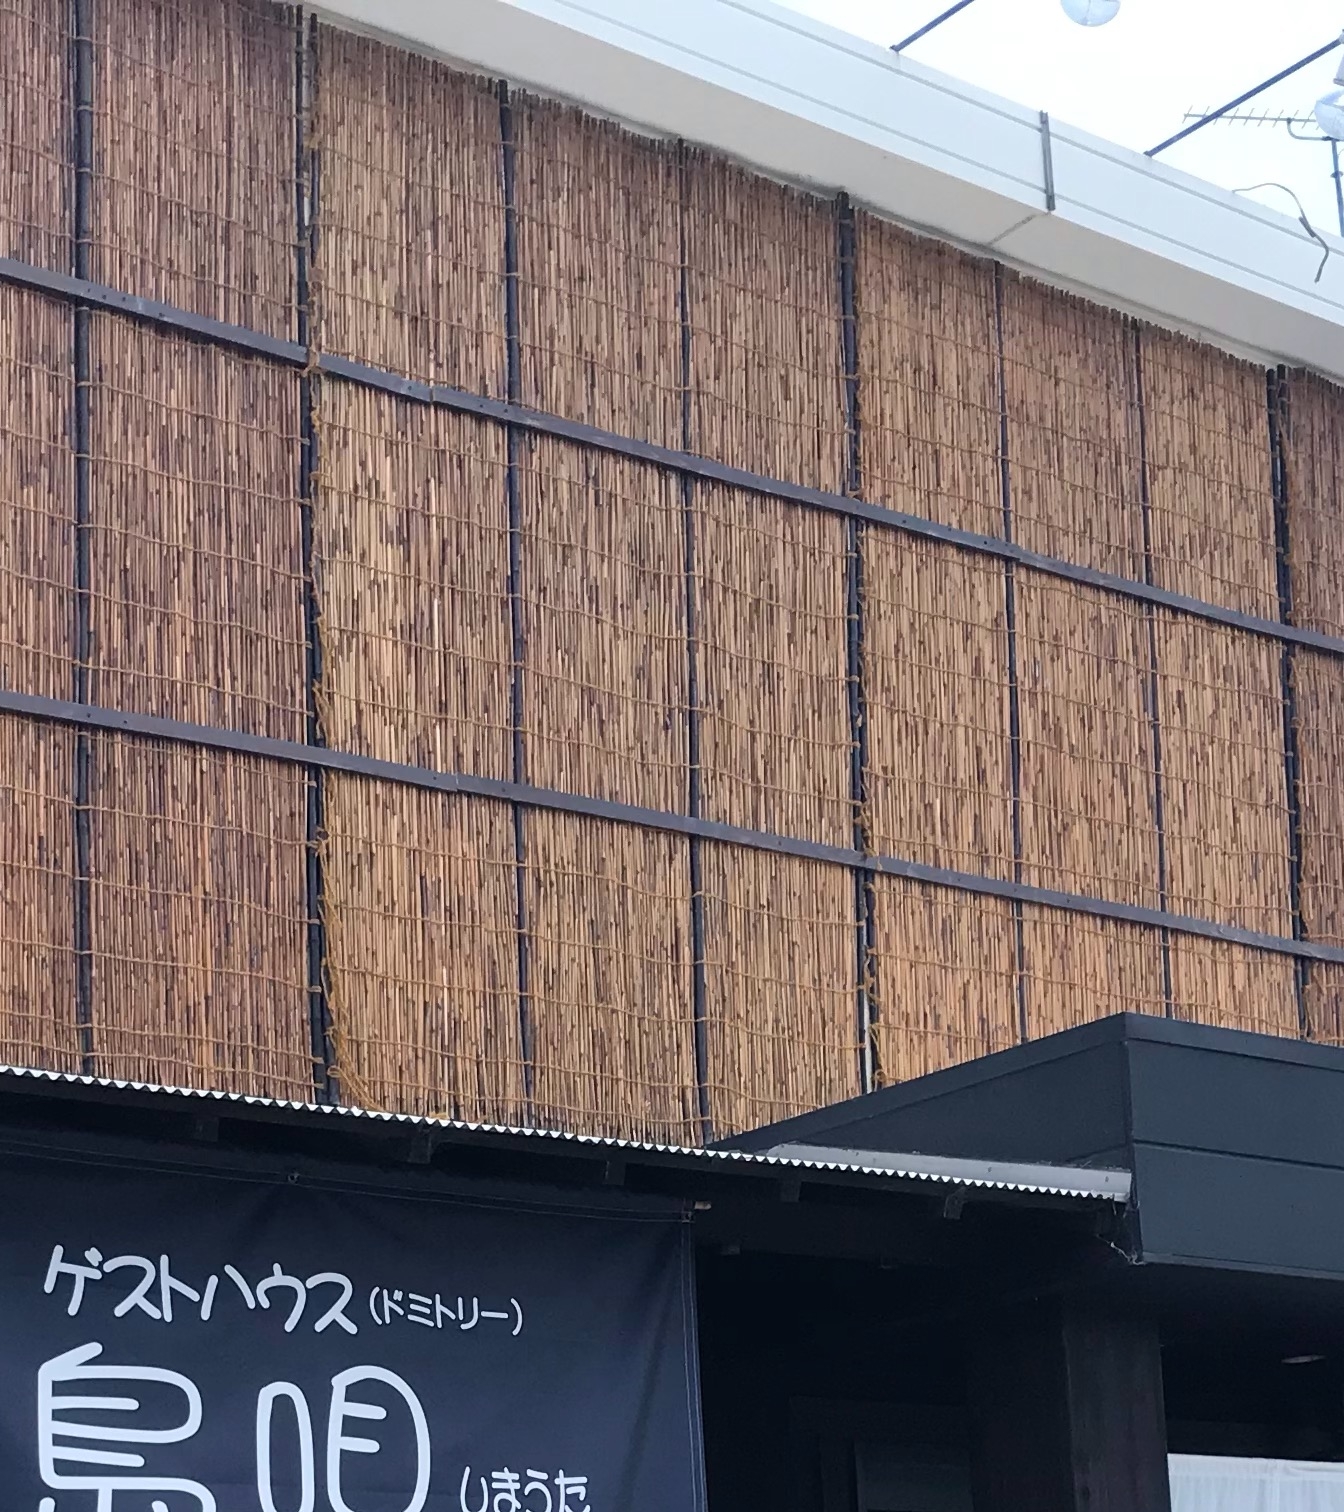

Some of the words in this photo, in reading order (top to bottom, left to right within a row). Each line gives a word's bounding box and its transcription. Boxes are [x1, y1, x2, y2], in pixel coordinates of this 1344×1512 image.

[43, 1243, 358, 1335] ゲストハウス
[369, 1285, 524, 1336] (ドミトリー)
